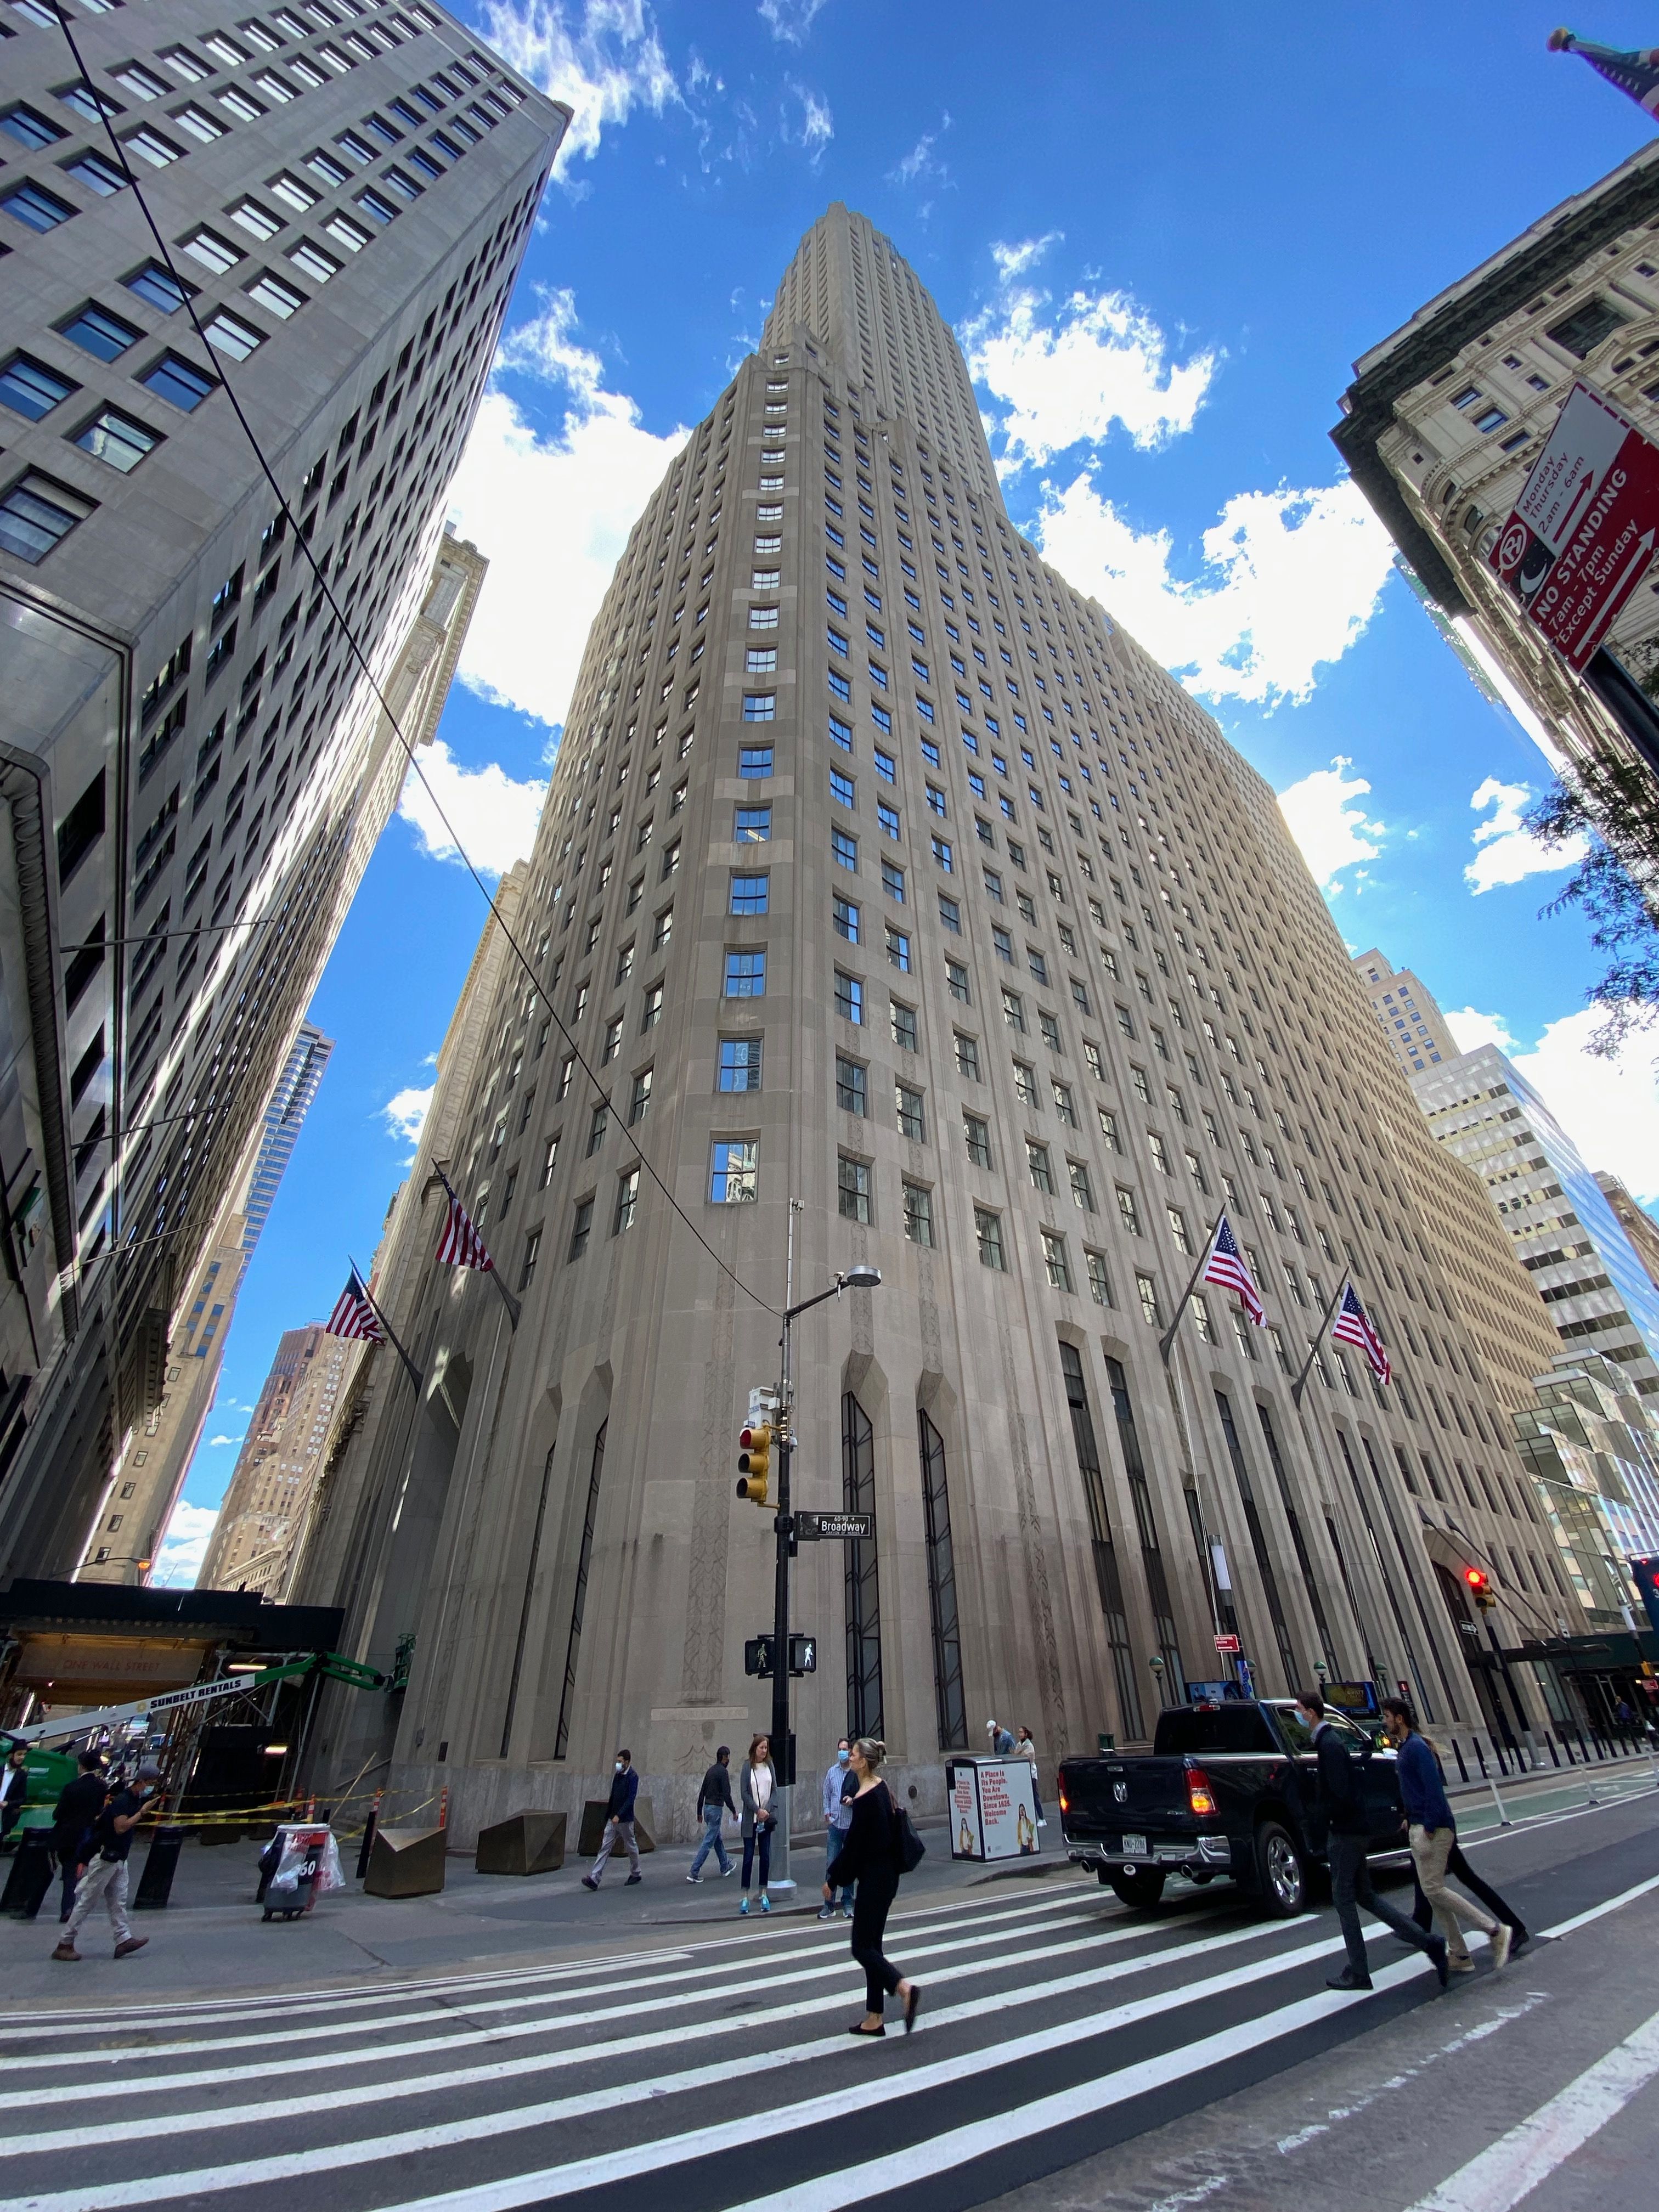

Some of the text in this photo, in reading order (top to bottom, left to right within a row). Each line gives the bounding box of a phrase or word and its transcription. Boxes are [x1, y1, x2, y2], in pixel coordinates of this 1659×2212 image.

[1523, 456, 1554, 513] Monday
[1530, 453, 1568, 518] Thursday
[1538, 501, 1560, 534] 2am
[1565, 456, 1584, 488] 6am
[1536, 469, 1628, 620] NO STANDING
[1549, 595, 1575, 630] 7am
[1577, 545, 1605, 583] 7pm
[1559, 519, 1638, 644] Except Sunday
[821, 1521, 865, 1534] Broadway
[63, 1660, 160, 1671] ONE WALL STREET
[150, 1679, 241, 1709] SUNBELT RENTALS
[983, 1793, 1009, 1802] Downtown.
